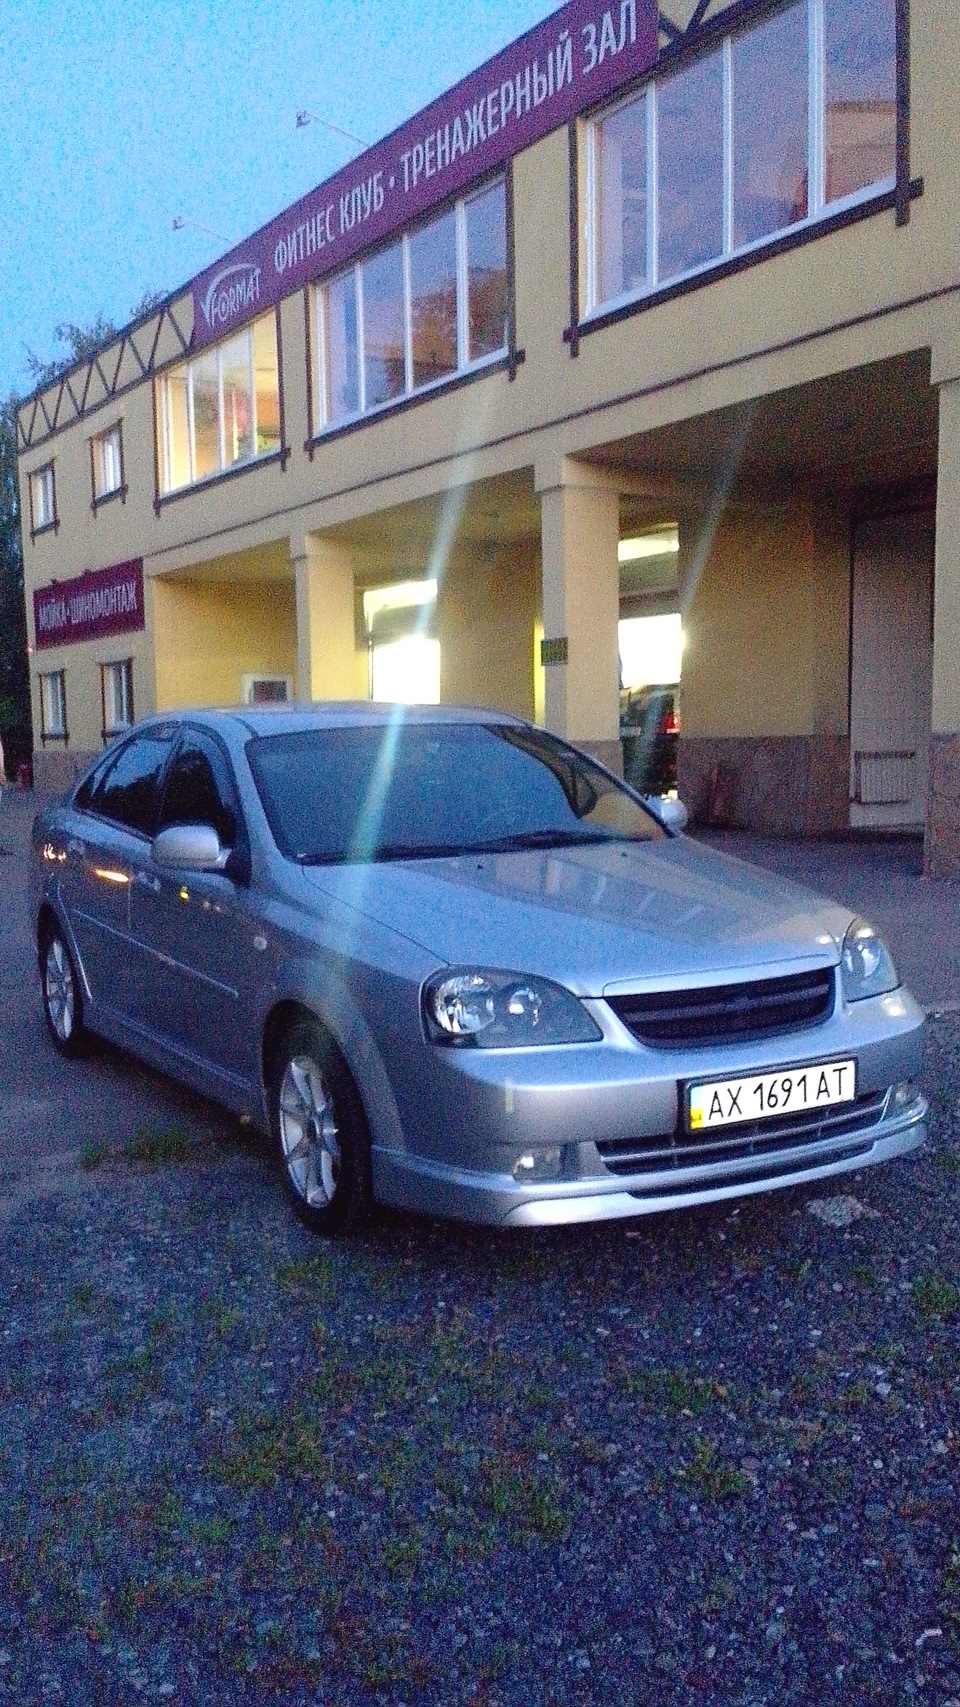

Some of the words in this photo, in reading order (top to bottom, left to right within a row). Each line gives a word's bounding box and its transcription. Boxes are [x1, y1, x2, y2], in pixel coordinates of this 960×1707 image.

[274, 204, 335, 275] ФИТНЕС
[340, 171, 384, 234] КЛУБ
[400, 29, 573, 193] ТРЕНАЖЕРНЫЙ
[582, 0, 636, 75] ЗАЛ
[204, 266, 261, 327] FORMAT
[708, 1085, 743, 1120] AX
[753, 1073, 808, 1111] 1691
[816, 1066, 848, 1100] AT
